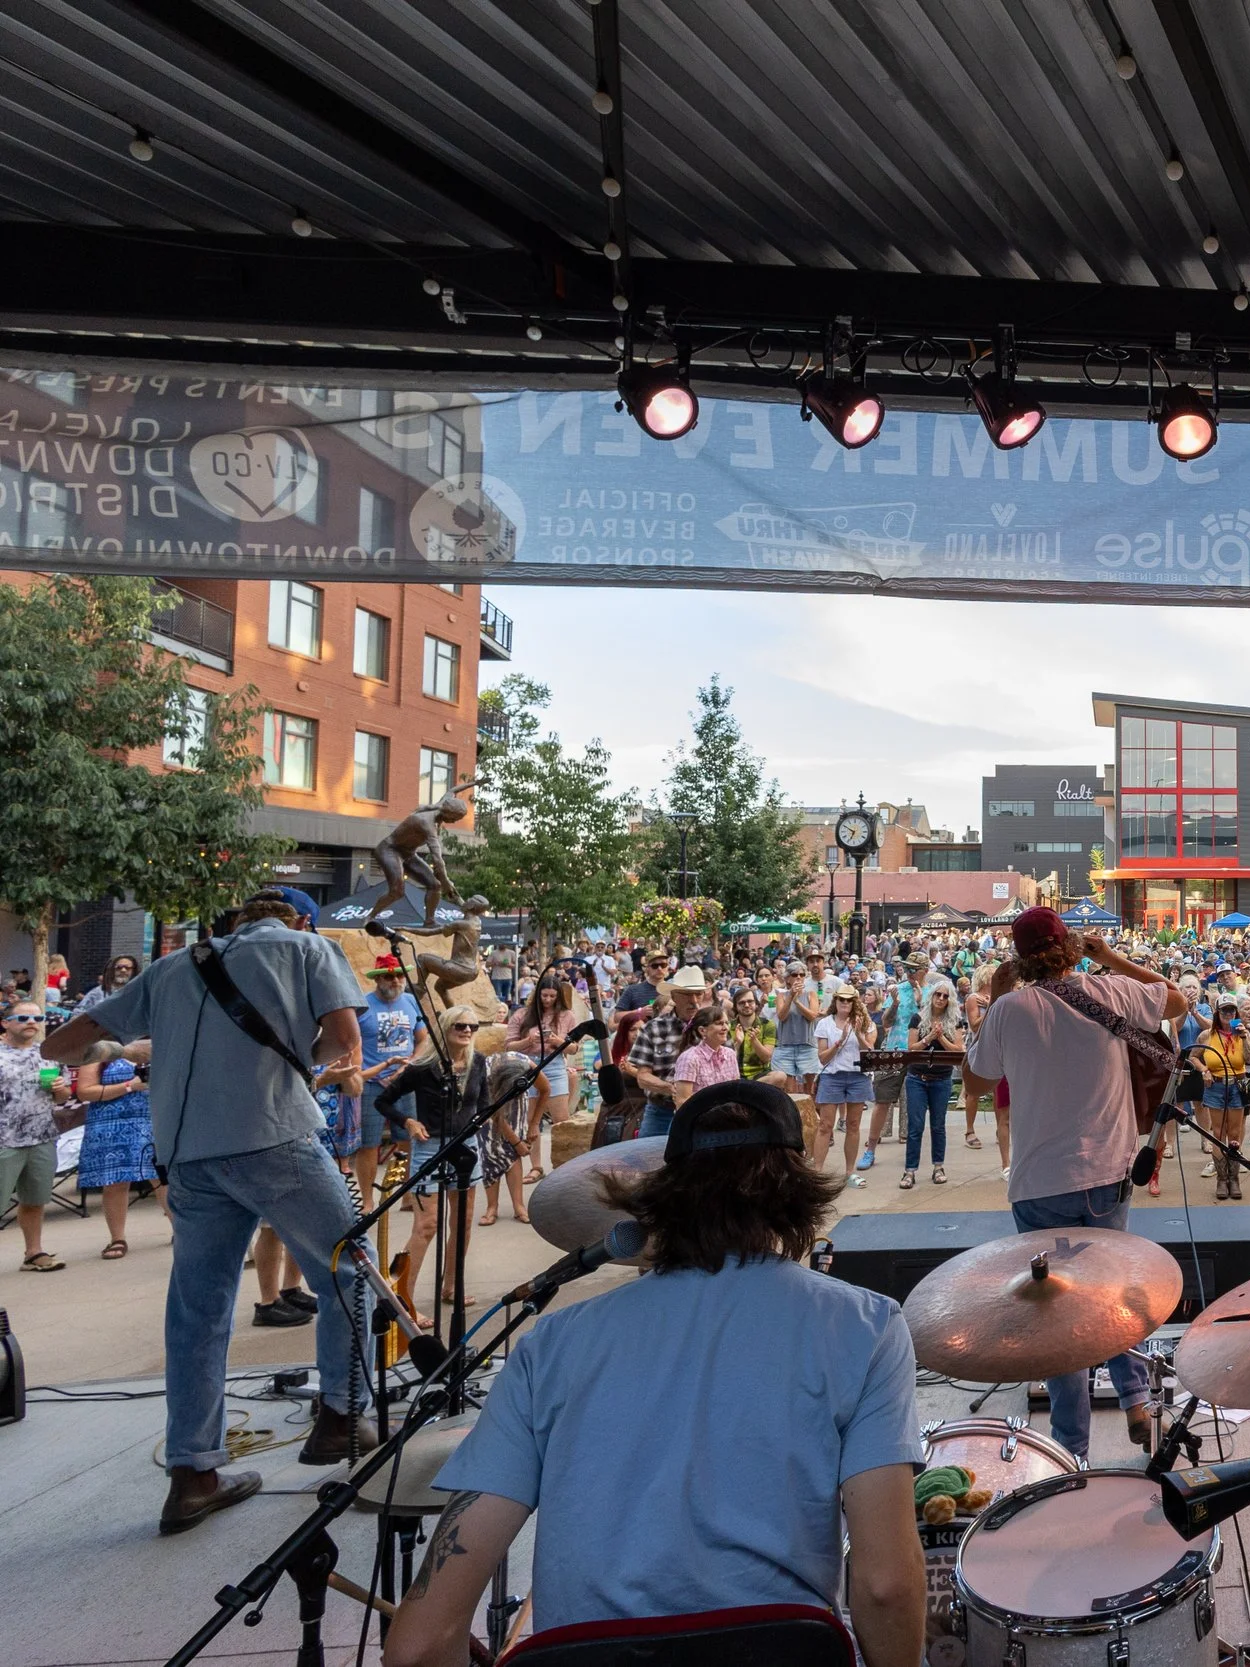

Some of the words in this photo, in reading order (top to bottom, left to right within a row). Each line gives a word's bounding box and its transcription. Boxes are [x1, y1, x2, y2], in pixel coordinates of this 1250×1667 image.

[1056, 778, 1095, 801] Rialt
[336, 906, 395, 921] pule
[936, 1530, 964, 1546] KIC
